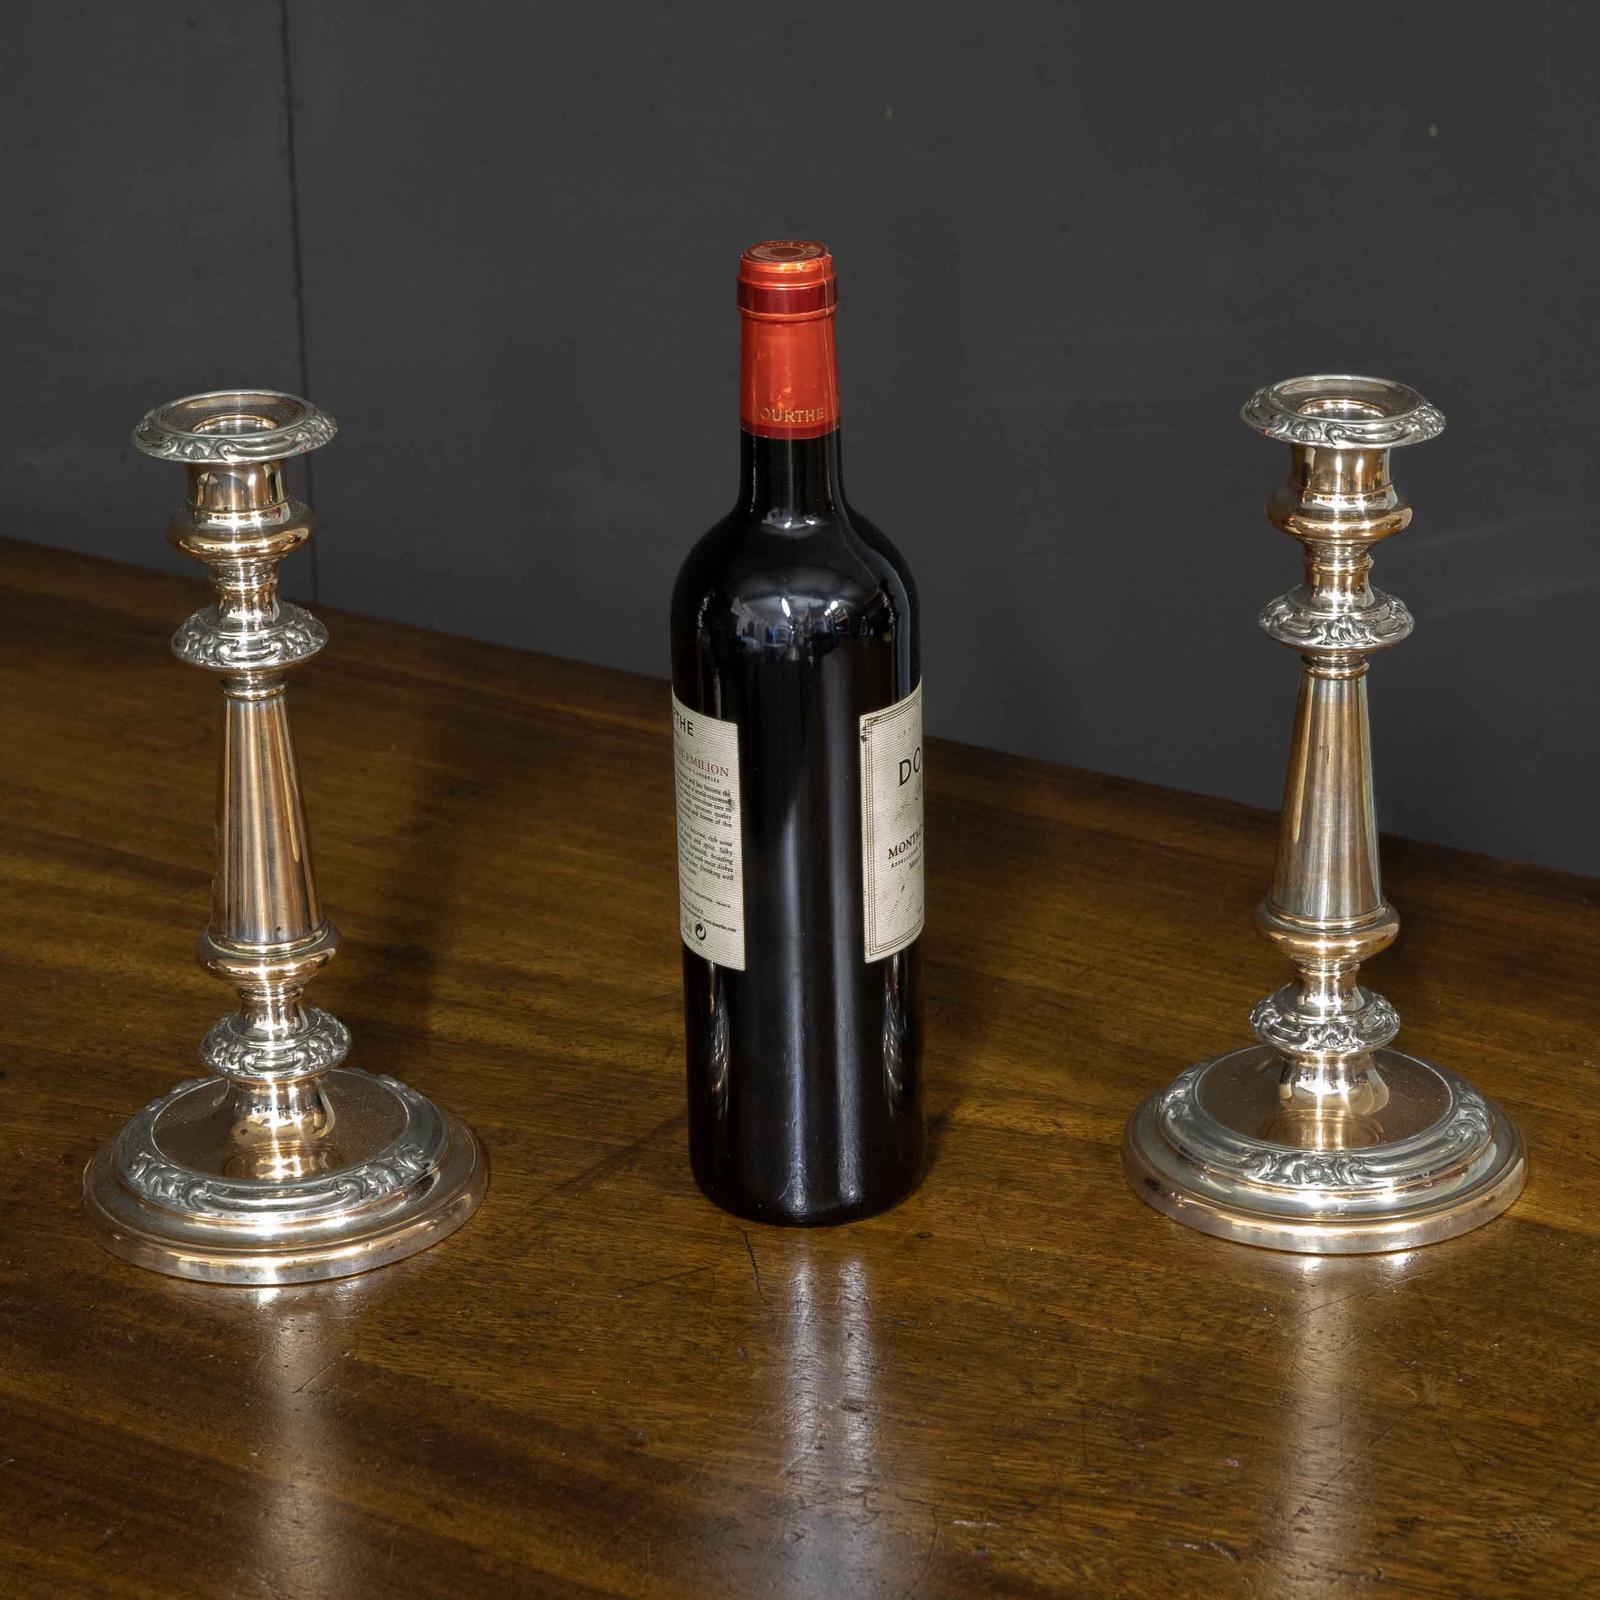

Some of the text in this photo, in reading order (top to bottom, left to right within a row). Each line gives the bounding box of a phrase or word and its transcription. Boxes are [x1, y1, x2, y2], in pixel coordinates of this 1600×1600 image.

[674, 709, 694, 737] THE
[720, 847, 733, 857] Silky
[722, 873, 734, 881] well
